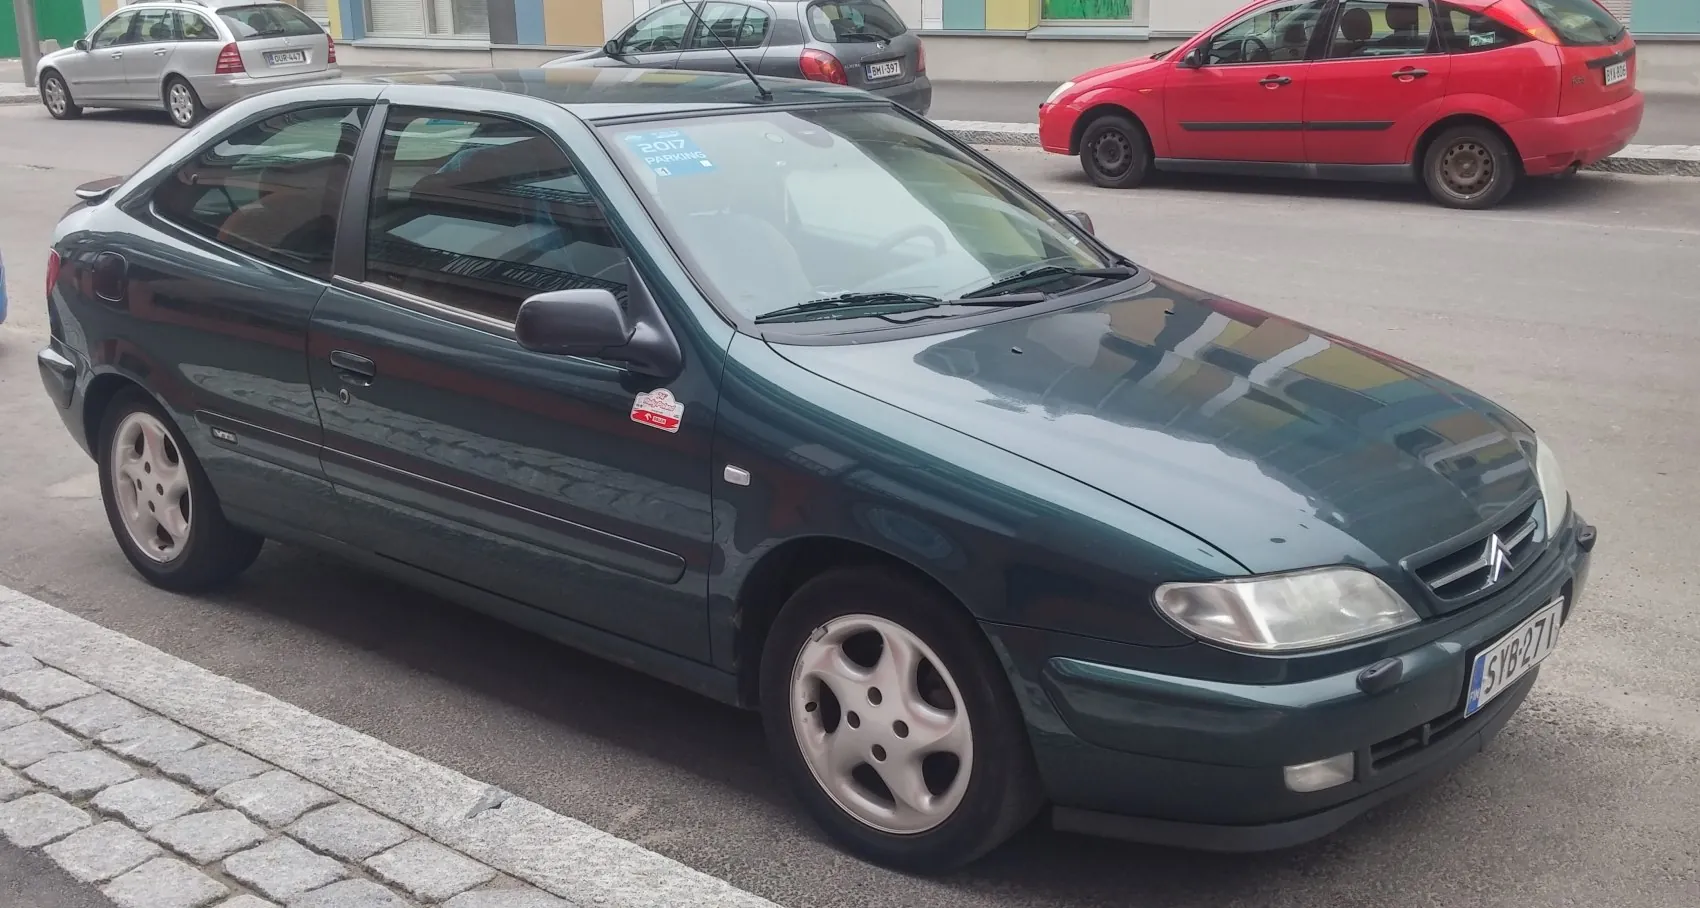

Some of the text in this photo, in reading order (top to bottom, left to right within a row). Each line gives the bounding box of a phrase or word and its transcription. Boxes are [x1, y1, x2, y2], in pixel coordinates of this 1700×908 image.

[871, 62, 898, 77] BMI-397
[637, 139, 685, 153] 2017
[644, 151, 707, 165] PARKING
[1484, 612, 1555, 695] SYB-271
